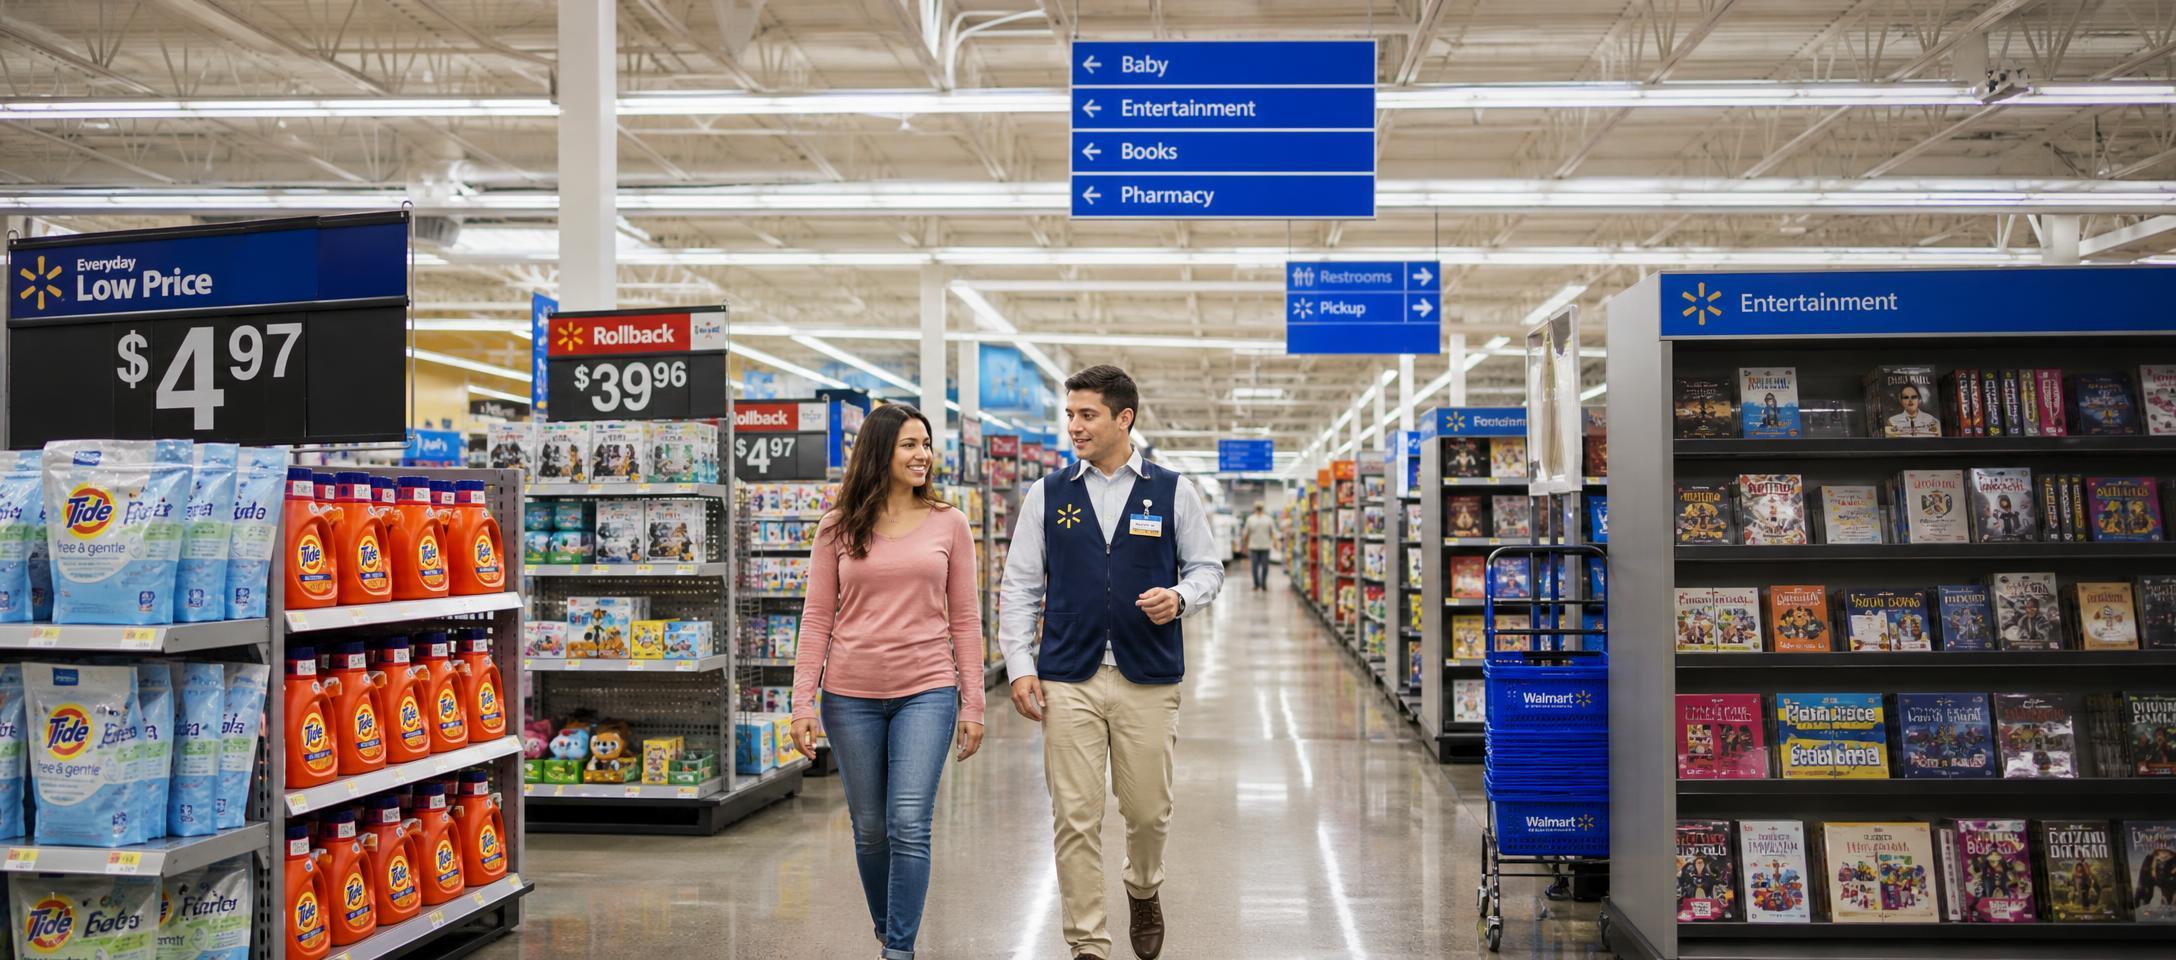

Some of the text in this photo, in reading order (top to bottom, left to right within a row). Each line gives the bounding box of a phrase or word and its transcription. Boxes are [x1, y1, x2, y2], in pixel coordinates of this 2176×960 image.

[1121, 55, 1168, 77] Baby
[1121, 99, 1256, 117] Entertainment
[1121, 142, 1178, 160] Books
[1121, 186, 1214, 208] Pharmacy
[77, 256, 136, 272] Everyday
[77, 267, 213, 301] Low Price
[1320, 270, 1393, 284] Restrooms
[1320, 300, 1366, 318] Pickup
[1741, 291, 1898, 314] Entertainment
[593, 323, 675, 346] Rollback
[66, 496, 113, 529] Tide
[88, 542, 125, 557] gentle
[301, 545, 320, 567] Tide
[1523, 692, 1574, 704] Walmart
[47, 715, 89, 749] Tide
[1525, 816, 1576, 828] Walmart
[27, 909, 74, 942] Tide
